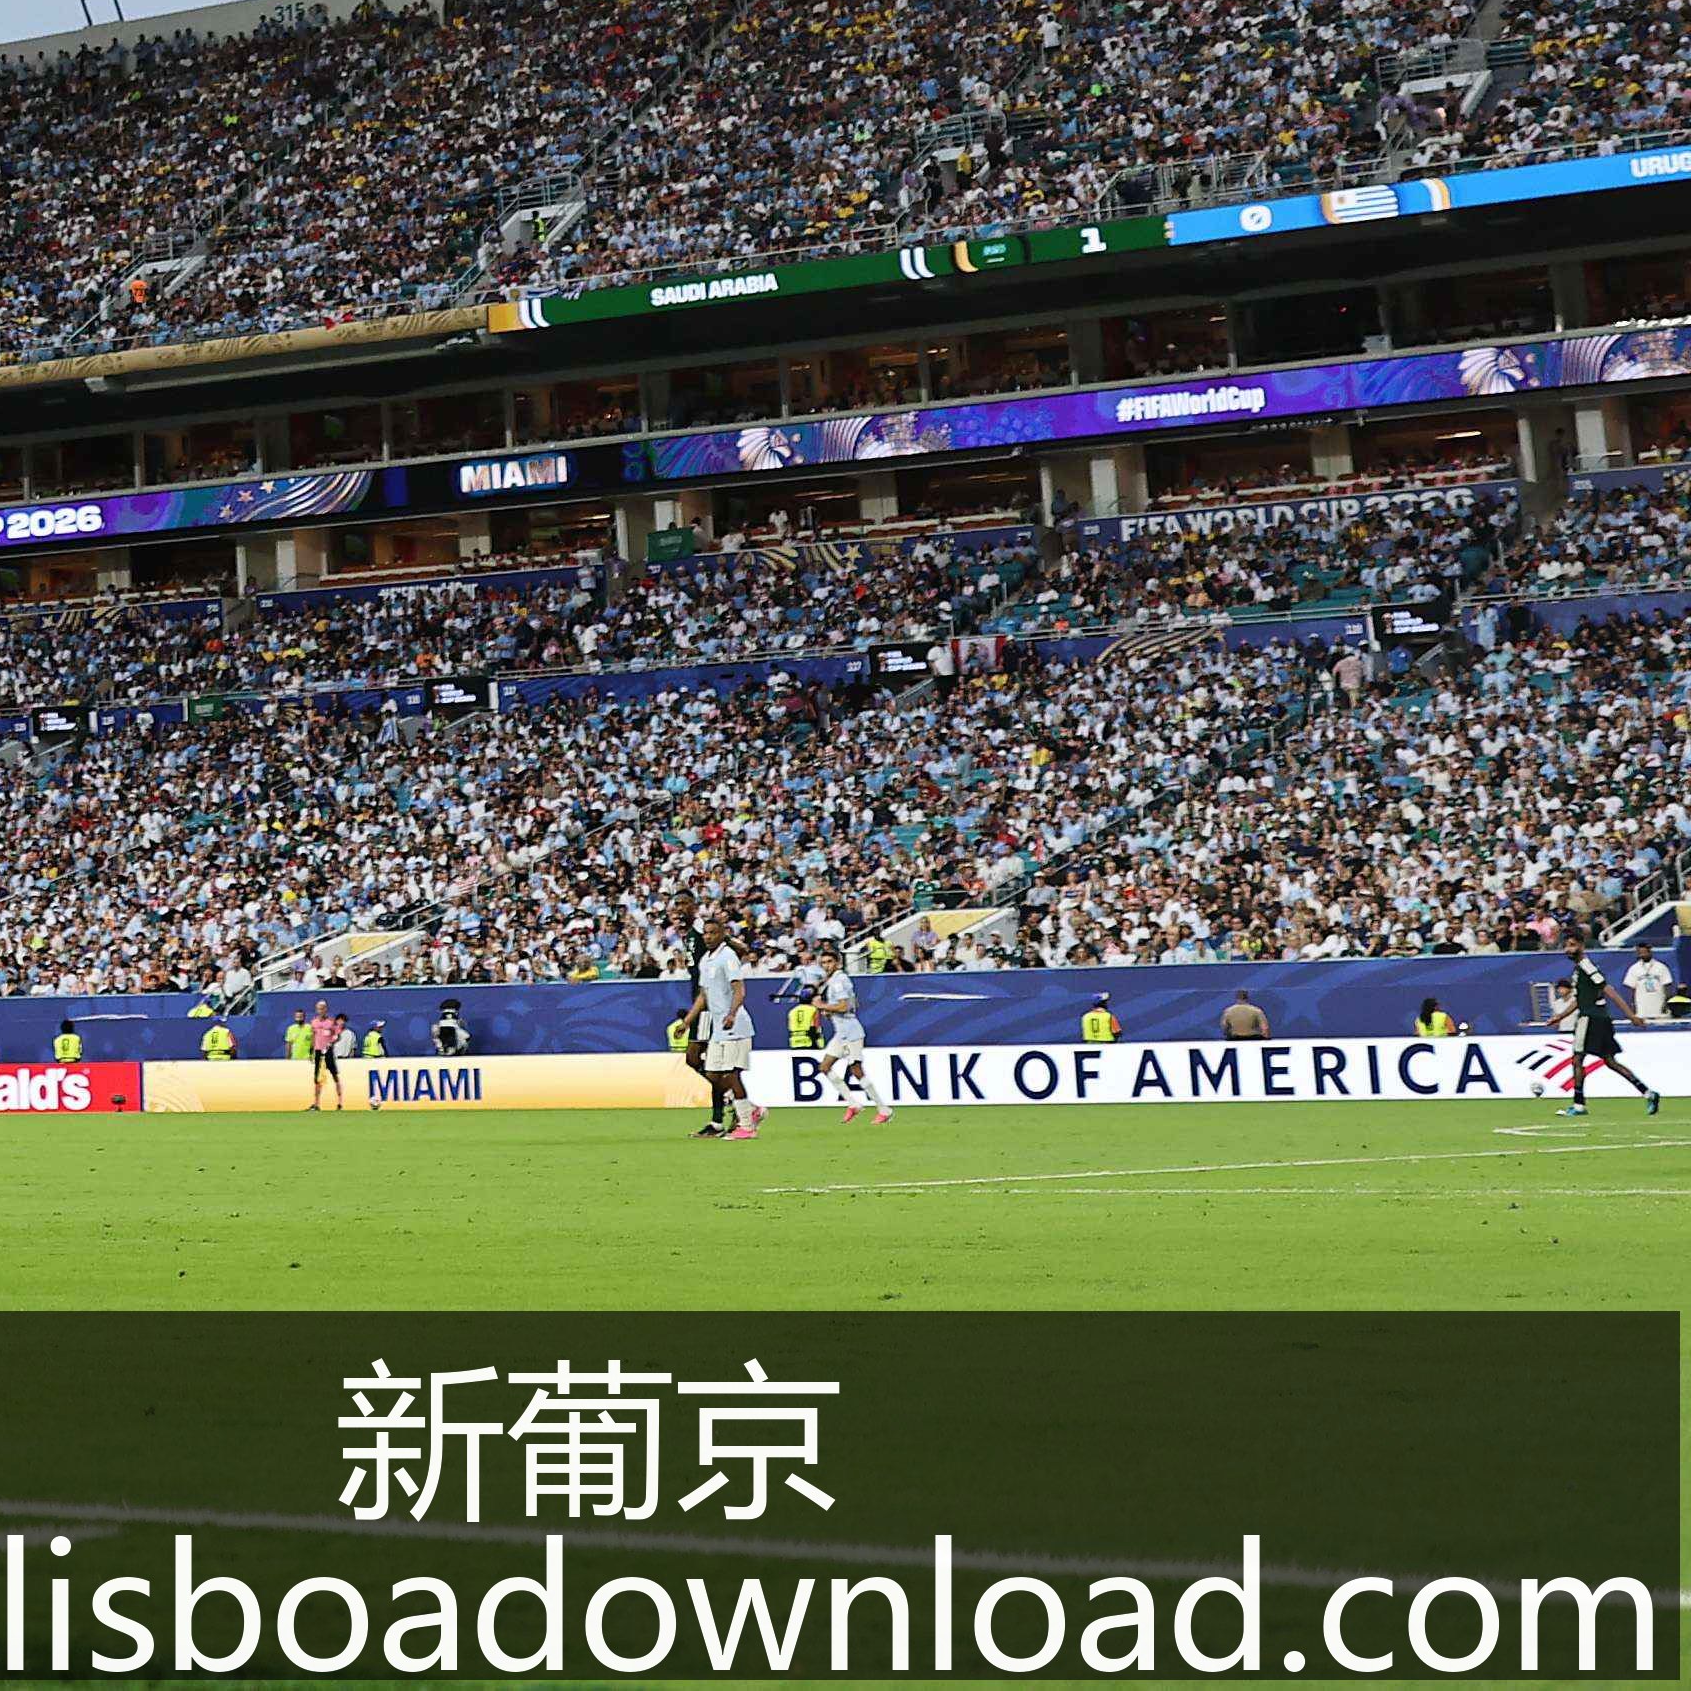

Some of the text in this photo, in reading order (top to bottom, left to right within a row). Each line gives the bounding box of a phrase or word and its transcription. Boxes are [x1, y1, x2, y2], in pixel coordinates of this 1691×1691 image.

[1080, 227, 1107, 253] 1
[650, 273, 779, 307] SAUDI ARABIA
[1115, 386, 1267, 423] #FIFAWorldCup
[460, 456, 569, 493] MIAMI
[5, 504, 103, 540] 2026
[369, 1067, 481, 1102] MIAMI
[1013, 1049, 1103, 1100] OF
[1130, 1042, 1502, 1098] AMERICA
